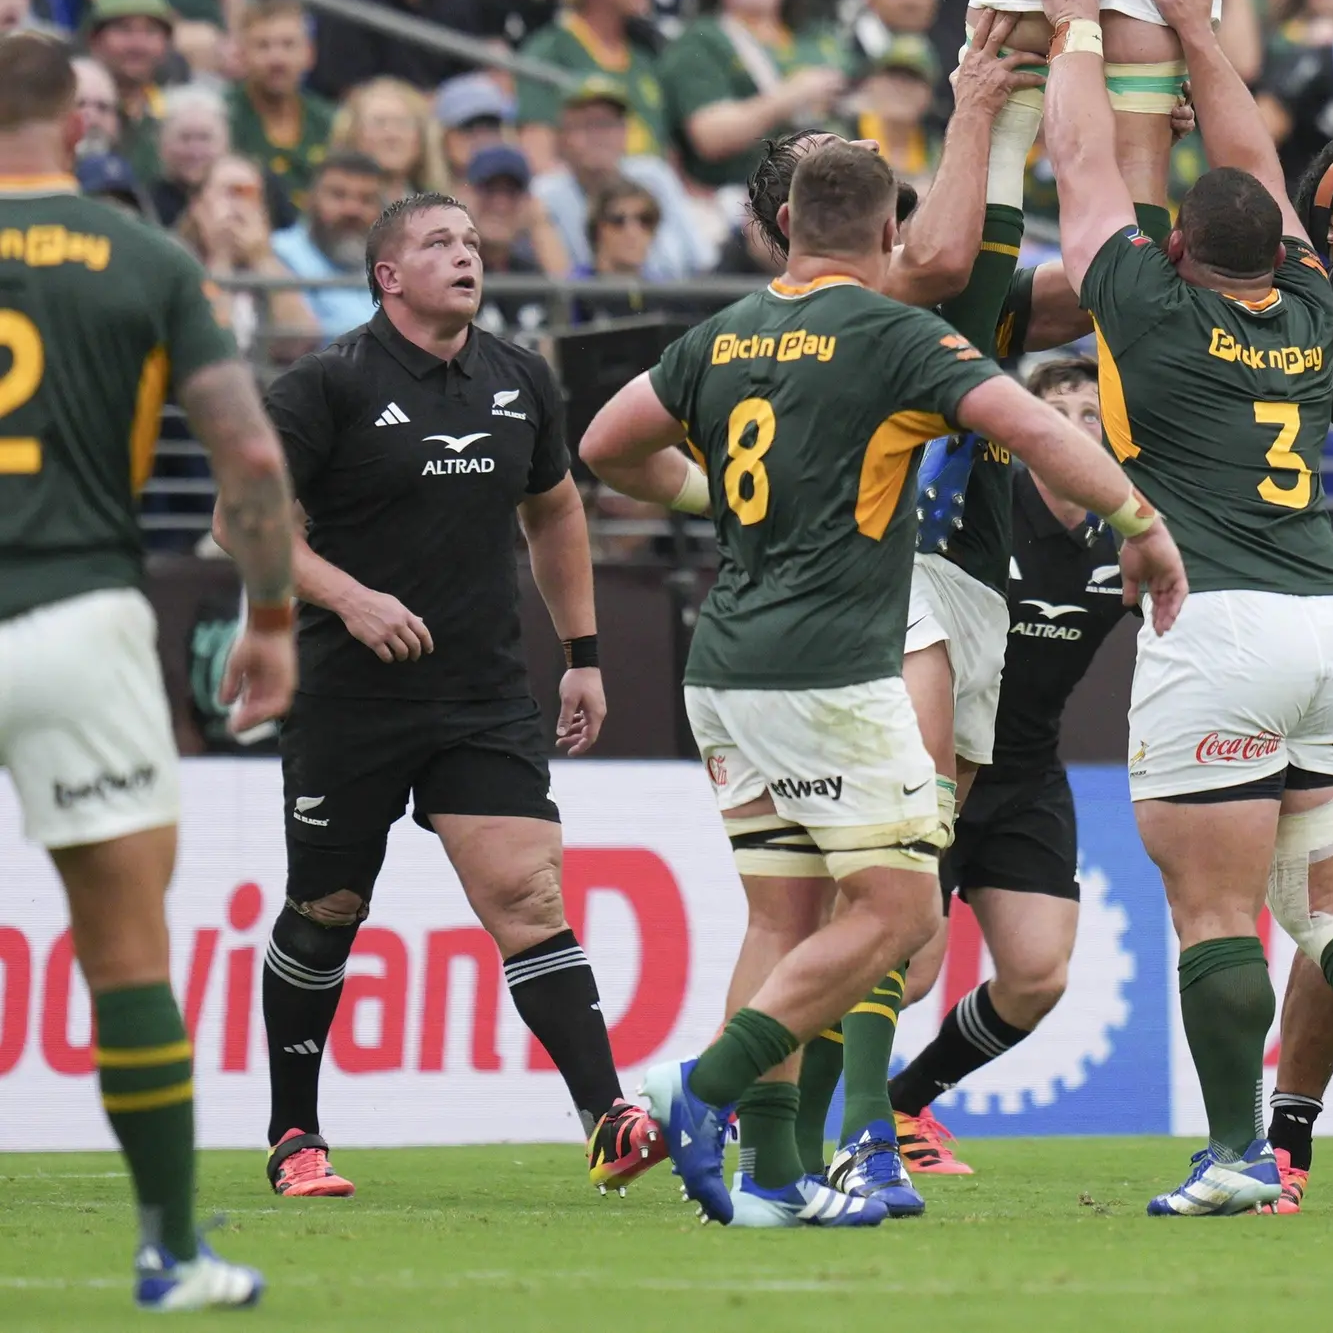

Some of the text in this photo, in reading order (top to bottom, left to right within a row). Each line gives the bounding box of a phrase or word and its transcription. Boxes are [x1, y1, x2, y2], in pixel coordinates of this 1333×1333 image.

[25, 224, 111, 271] Pay
[776, 329, 837, 362] Pay
[1268, 349, 1284, 370] n
[1281, 346, 1323, 375] Pay
[0, 307, 45, 475] 2
[421, 458, 496, 476] ALTRAD
[724, 397, 776, 526] 8
[1256, 400, 1313, 510] 3
[1010, 622, 1082, 641] ALTRAD
[770, 775, 843, 802] etway
